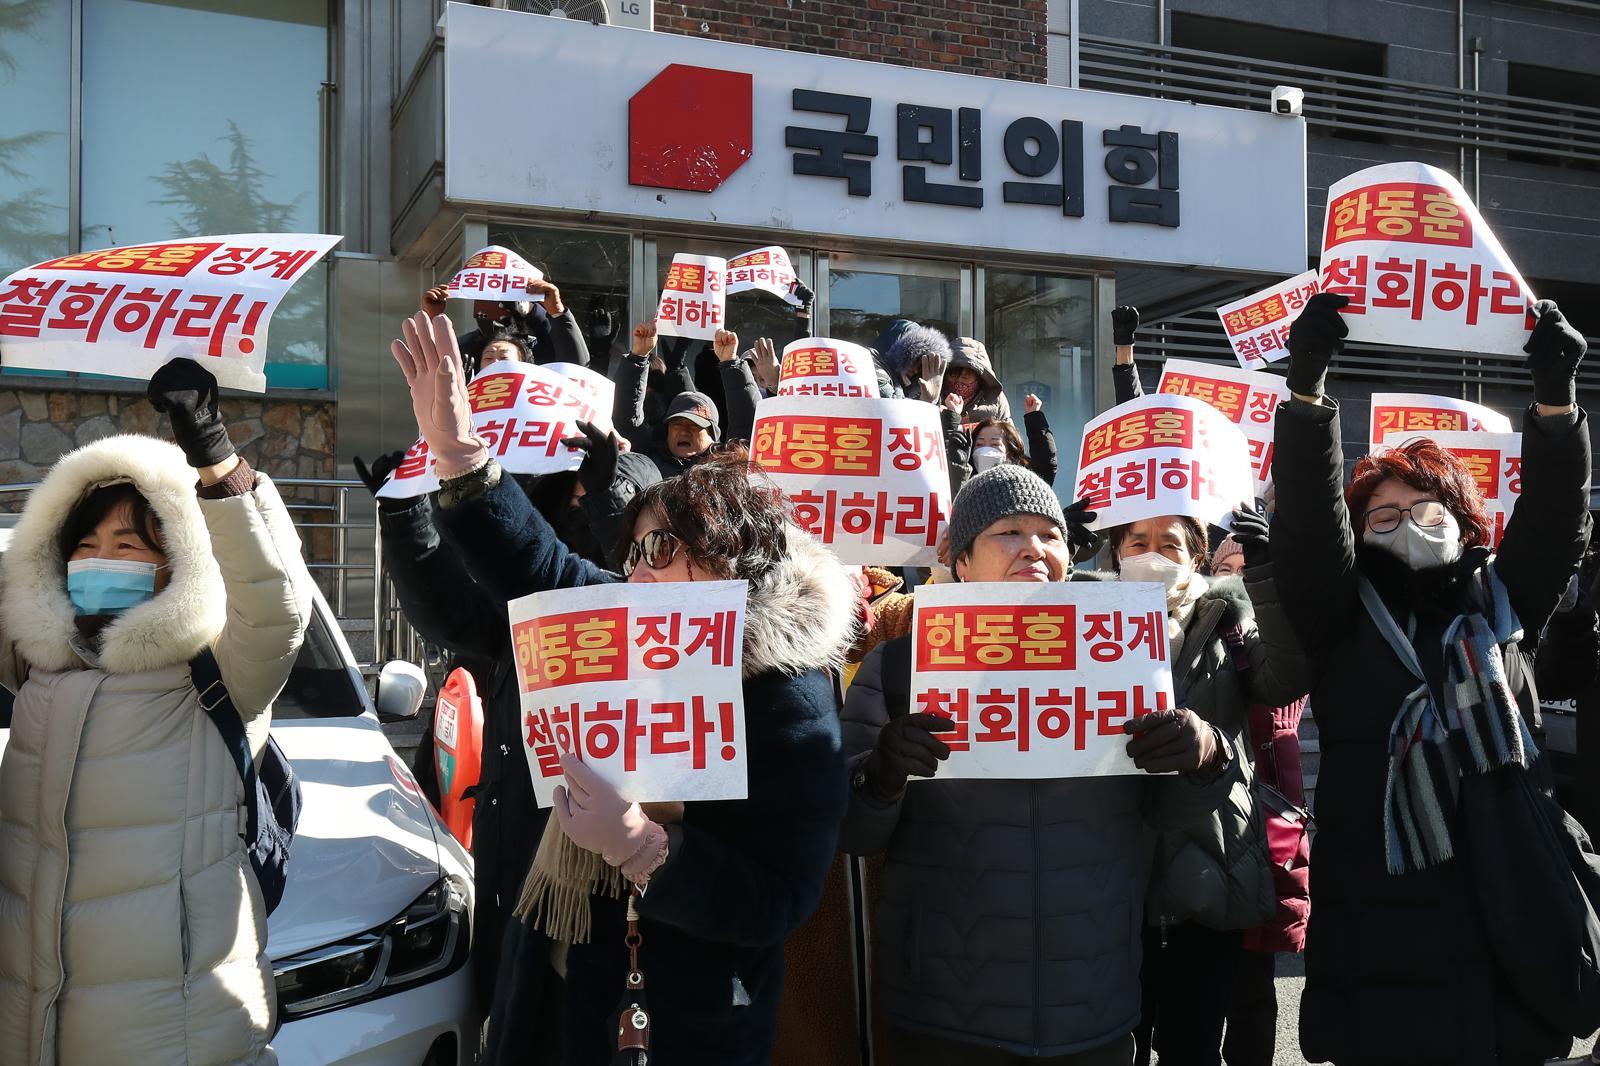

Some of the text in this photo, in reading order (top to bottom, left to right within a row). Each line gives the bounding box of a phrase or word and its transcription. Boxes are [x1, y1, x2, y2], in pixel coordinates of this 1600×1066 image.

[620, 1, 640, 16] LG
[785, 88, 1180, 228] 국민의힘
[1333, 190, 1465, 241] 한동훈
[208, 247, 316, 281] 징계
[666, 265, 701, 291] 동훈
[0, 277, 268, 357] 철회하라!
[1226, 280, 1319, 333] 한동훈 징계
[783, 350, 835, 378] 한동훈
[756, 422, 946, 473] 한동훈 징계
[1088, 410, 1187, 461] 한동훈
[516, 610, 737, 686] 한동훈 징계
[925, 611, 1166, 664] 한동훈 징계
[525, 695, 737, 778] 철회하라!
